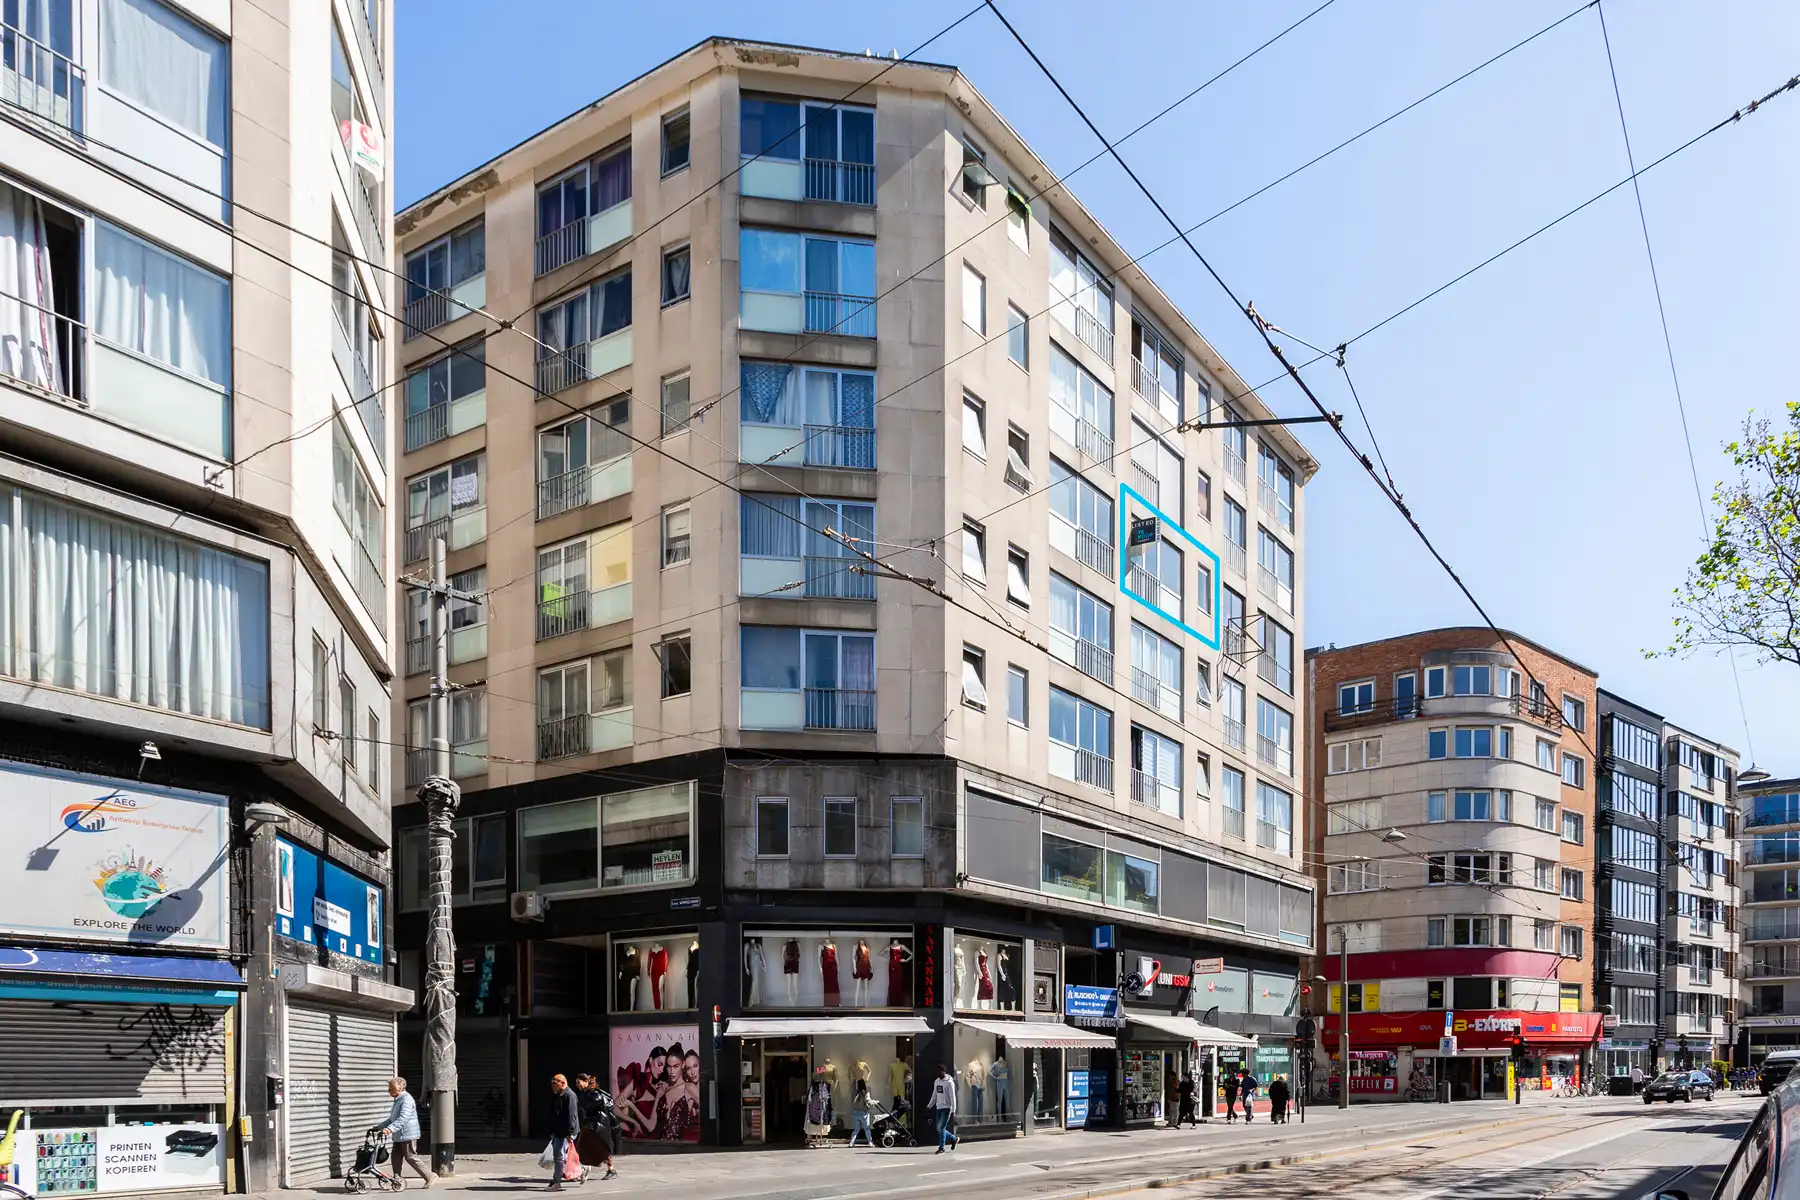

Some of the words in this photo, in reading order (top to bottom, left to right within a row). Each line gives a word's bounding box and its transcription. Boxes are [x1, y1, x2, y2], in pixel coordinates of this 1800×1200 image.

[1132, 520, 1154, 528] LISTED
[114, 798, 136, 807] AEG
[109, 815, 140, 825] Antwerp
[143, 820, 179, 831] Enterprise
[182, 826, 204, 834] Group
[654, 853, 680, 862] HEYLEN
[73, 918, 128, 930] EXPLORE
[132, 923, 153, 932] THE
[156, 925, 195, 935] WORLD
[1095, 927, 1109, 948] L
[924, 924, 935, 1007] SAVANNAH
[1158, 972, 1173, 985] UNI
[617, 1033, 695, 1043] SAVANNAH
[1355, 1051, 1384, 1059] Morgen
[1351, 1079, 1380, 1089] ETFLIX
[110, 1142, 152, 1152] PRINTEN
[104, 1154, 157, 1164] SCANNEN
[105, 1165, 156, 1175] KOPIEREN
